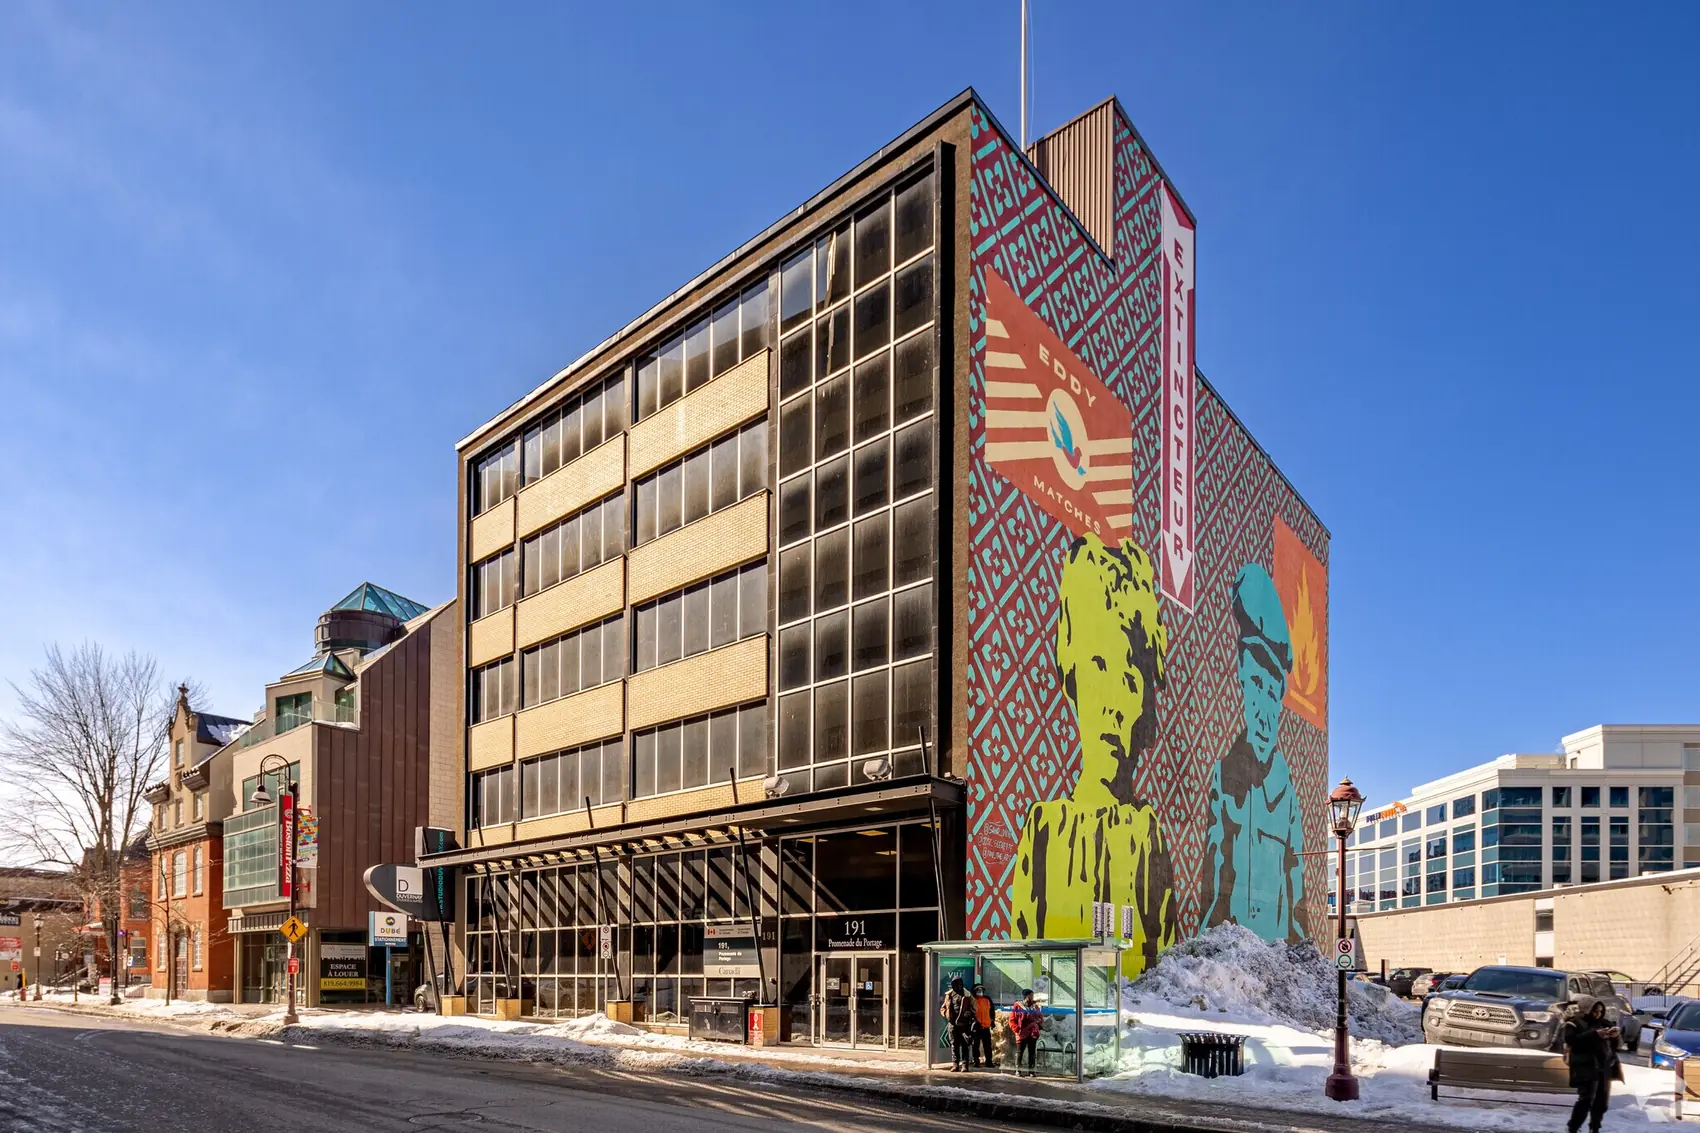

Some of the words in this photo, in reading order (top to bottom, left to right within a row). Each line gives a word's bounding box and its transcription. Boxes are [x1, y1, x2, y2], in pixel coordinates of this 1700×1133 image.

[1038, 343, 1097, 409] EDDY
[1173, 237, 1184, 561] EXTINCTEUR
[1033, 475, 1101, 535] MATCHES
[398, 879, 409, 892] D
[762, 931, 775, 941] 191
[844, 920, 866, 936] 191
[828, 938, 855, 948] Promenade
[855, 937, 863, 947] du
[863, 938, 883, 949] Portage
